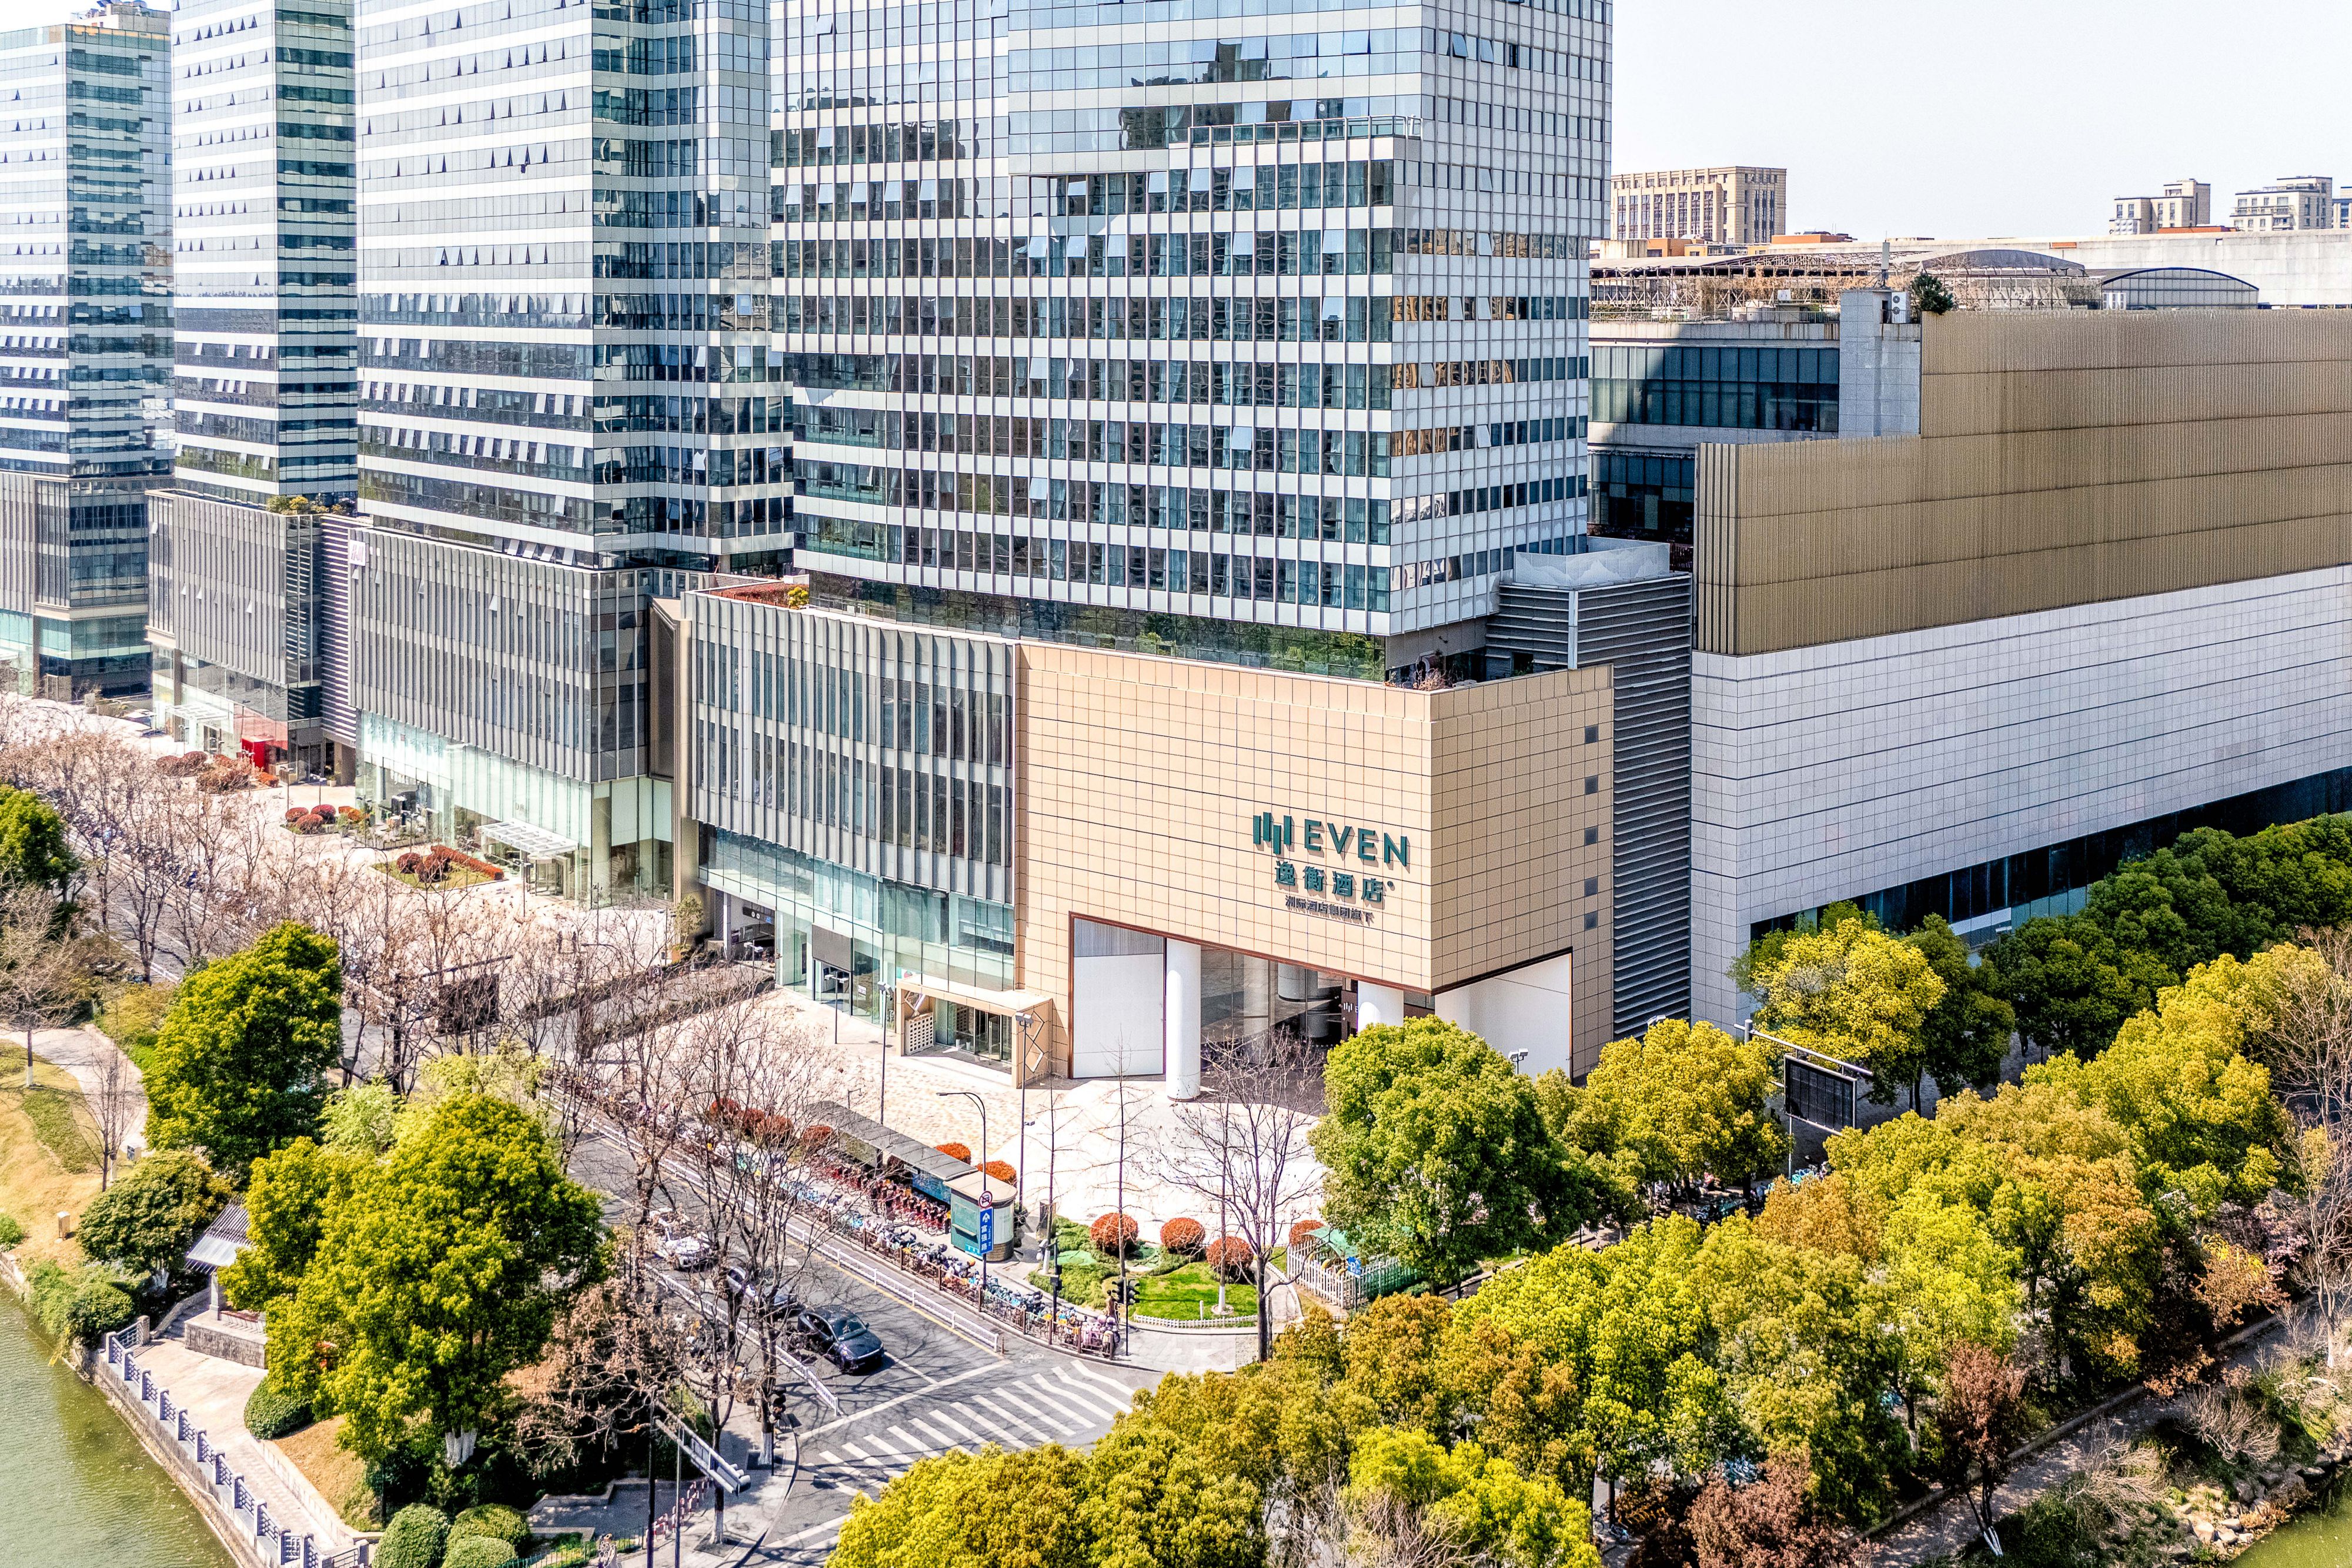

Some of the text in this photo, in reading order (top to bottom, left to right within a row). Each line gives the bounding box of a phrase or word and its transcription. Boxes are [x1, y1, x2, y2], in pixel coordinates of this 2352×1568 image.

[1304, 818, 1406, 867] EVEN
[1274, 861, 1383, 902] 逸衡酒店
[1285, 895, 1374, 924] 洲际酒店集团旗下
